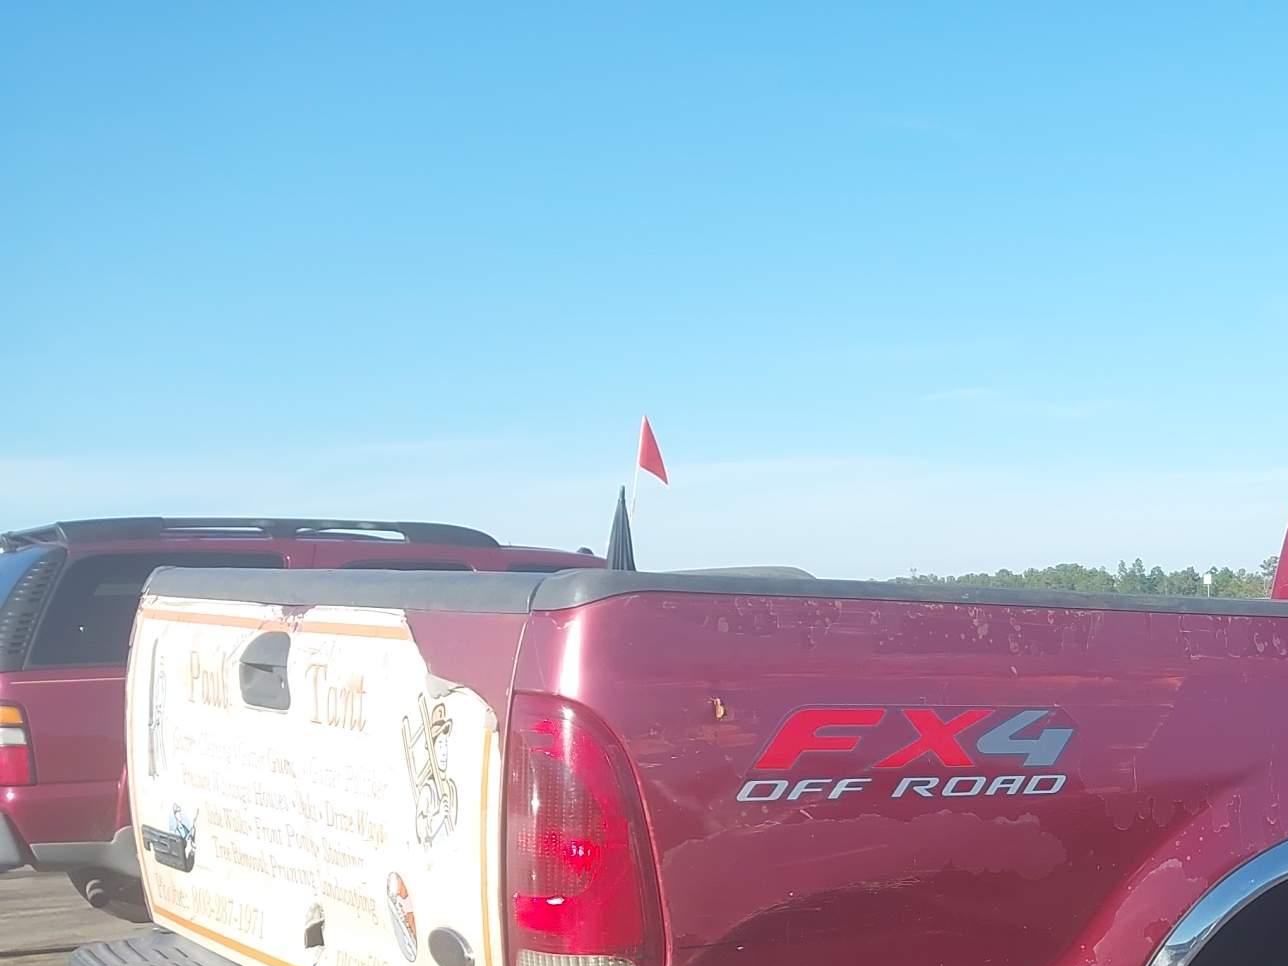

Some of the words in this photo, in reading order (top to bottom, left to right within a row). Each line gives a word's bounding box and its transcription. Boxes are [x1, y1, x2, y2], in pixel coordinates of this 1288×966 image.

[752, 708, 1075, 770] FX4
[736, 777, 873, 802] OFF
[891, 774, 1067, 798] ROAD
